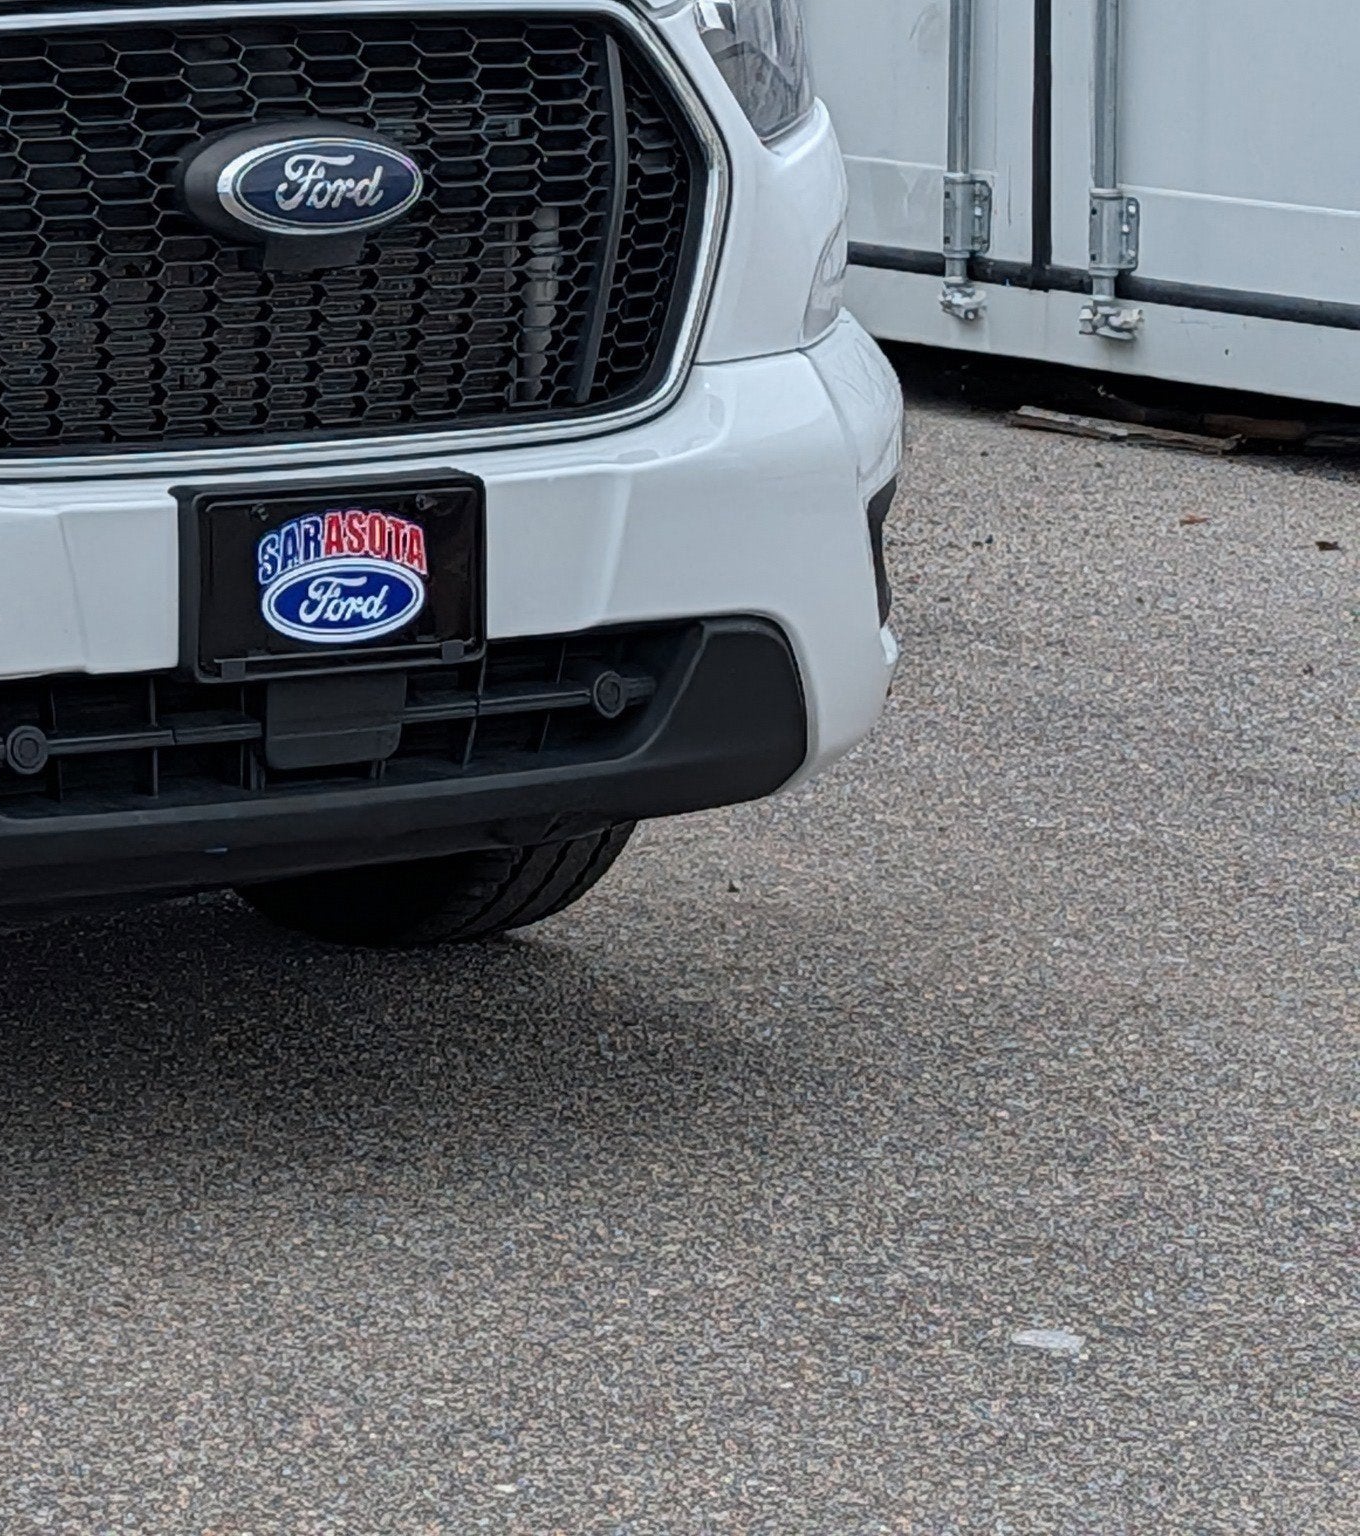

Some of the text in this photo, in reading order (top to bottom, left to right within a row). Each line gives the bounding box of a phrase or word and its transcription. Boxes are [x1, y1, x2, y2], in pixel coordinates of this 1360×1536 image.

[275, 153, 384, 211] Ford
[258, 508, 428, 585] SARASOTA
[298, 575, 390, 624] Ford
